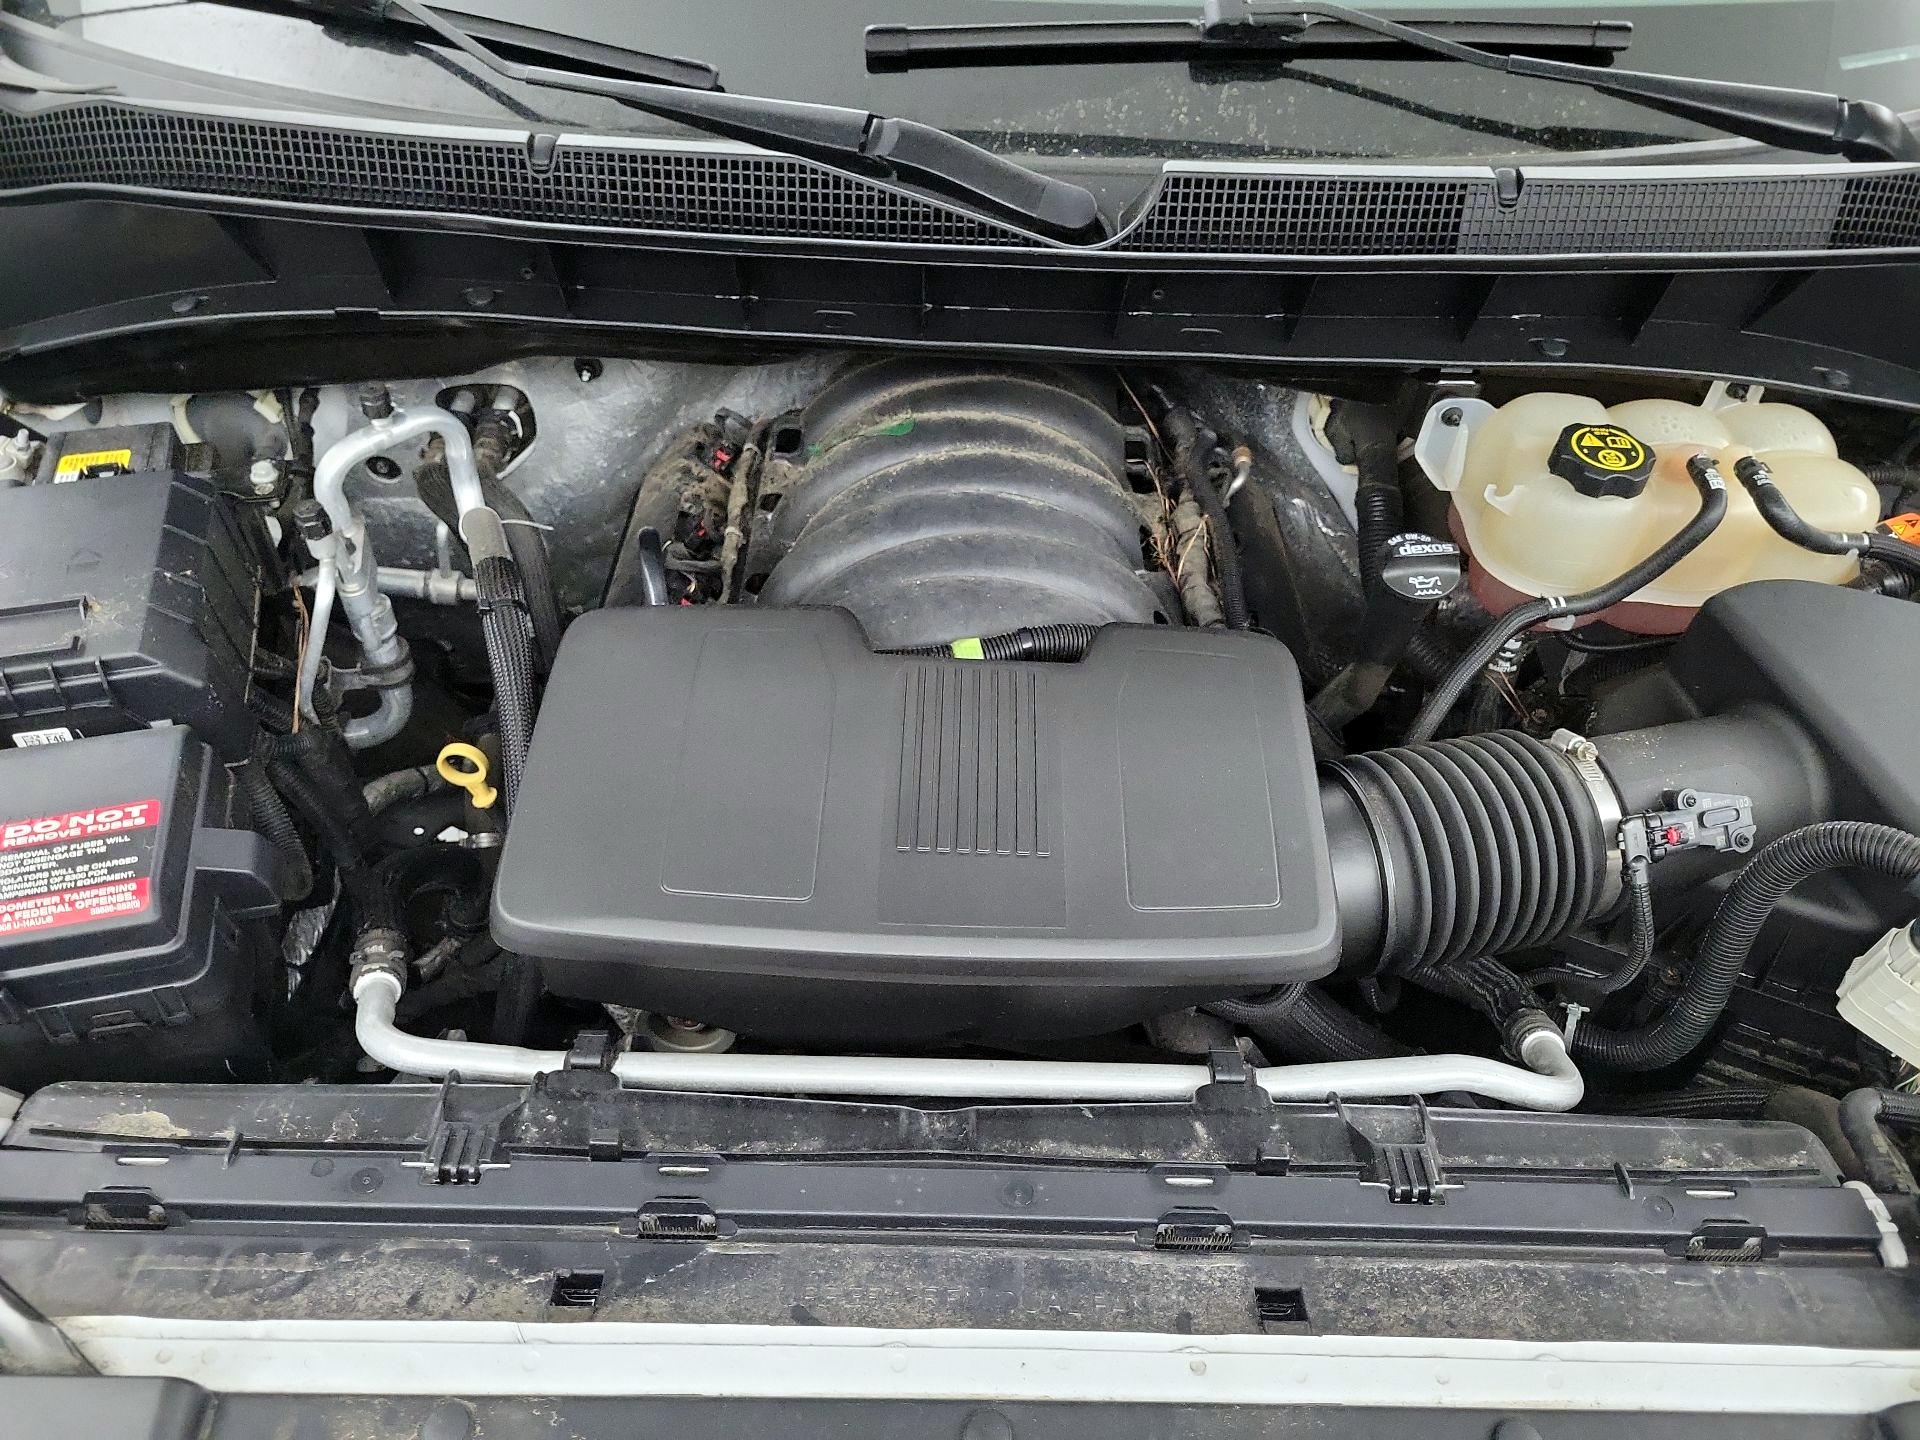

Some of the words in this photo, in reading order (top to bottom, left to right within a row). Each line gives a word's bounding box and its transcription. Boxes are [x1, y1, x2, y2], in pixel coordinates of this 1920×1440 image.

[1399, 543, 1454, 555] dexos
[3, 827, 82, 848] REMOVE
[87, 816, 146, 833] FUSES
[4, 820, 61, 839] DO
[69, 804, 149, 828] NOT
[0, 848, 50, 862] REMOVAL
[53, 845, 68, 854] OF
[70, 839, 104, 852] FUSES
[105, 834, 131, 845] WILL
[0, 860, 21, 870] NOT
[23, 850, 84, 866] DISENGAGE
[86, 845, 107, 855] THE
[0, 871, 50, 887] IOLATORS
[51, 867, 74, 877] WILL
[76, 864, 90, 873] BE
[91, 855, 139, 870] CHARGED
[2, 878, 48, 893] MINIMUM
[50, 876, 64, 884] OF
[88, 868, 108, 878] FOR
[50, 881, 75, 891] WITH
[76, 870, 136, 887] EQUIPMENT.
[0, 896, 61, 915] DOMETER
[63, 882, 138, 902] TAMPERING
[14, 902, 73, 920] FEDERAL
[75, 891, 137, 910] OFFENSE.
